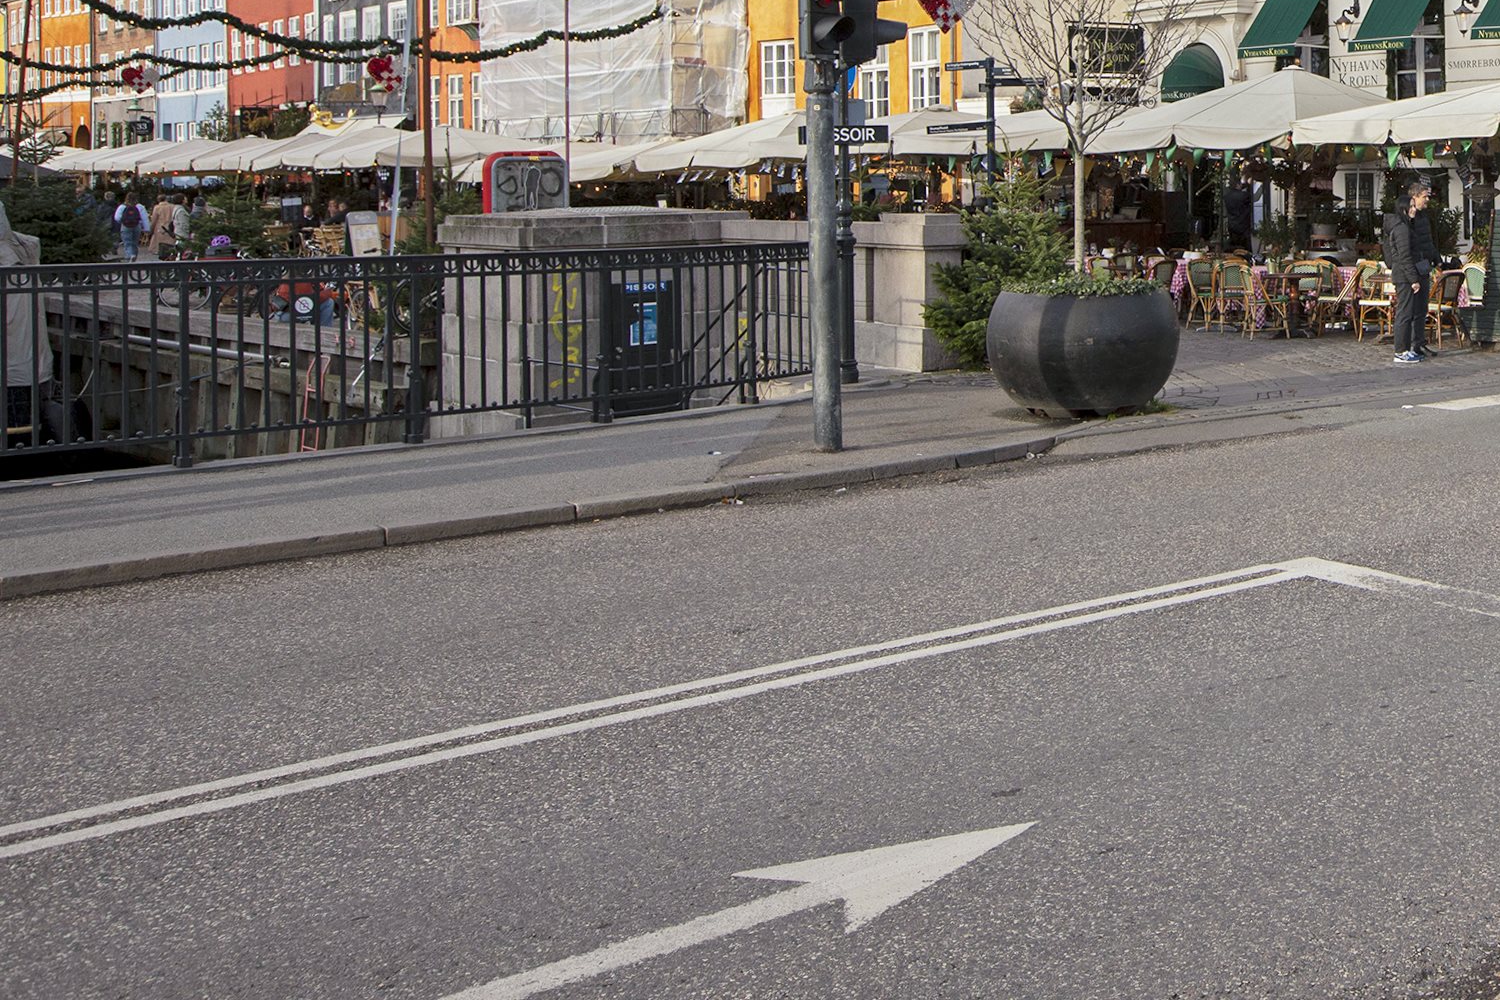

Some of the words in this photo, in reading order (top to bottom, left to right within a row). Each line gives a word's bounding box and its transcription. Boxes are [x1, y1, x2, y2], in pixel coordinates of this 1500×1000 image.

[1093, 39, 1136, 51] NYHVNS
[1331, 57, 1386, 74] NYHAVNS
[1338, 73, 1378, 87] KROEN
[625, 283, 665, 291] PISSOR
